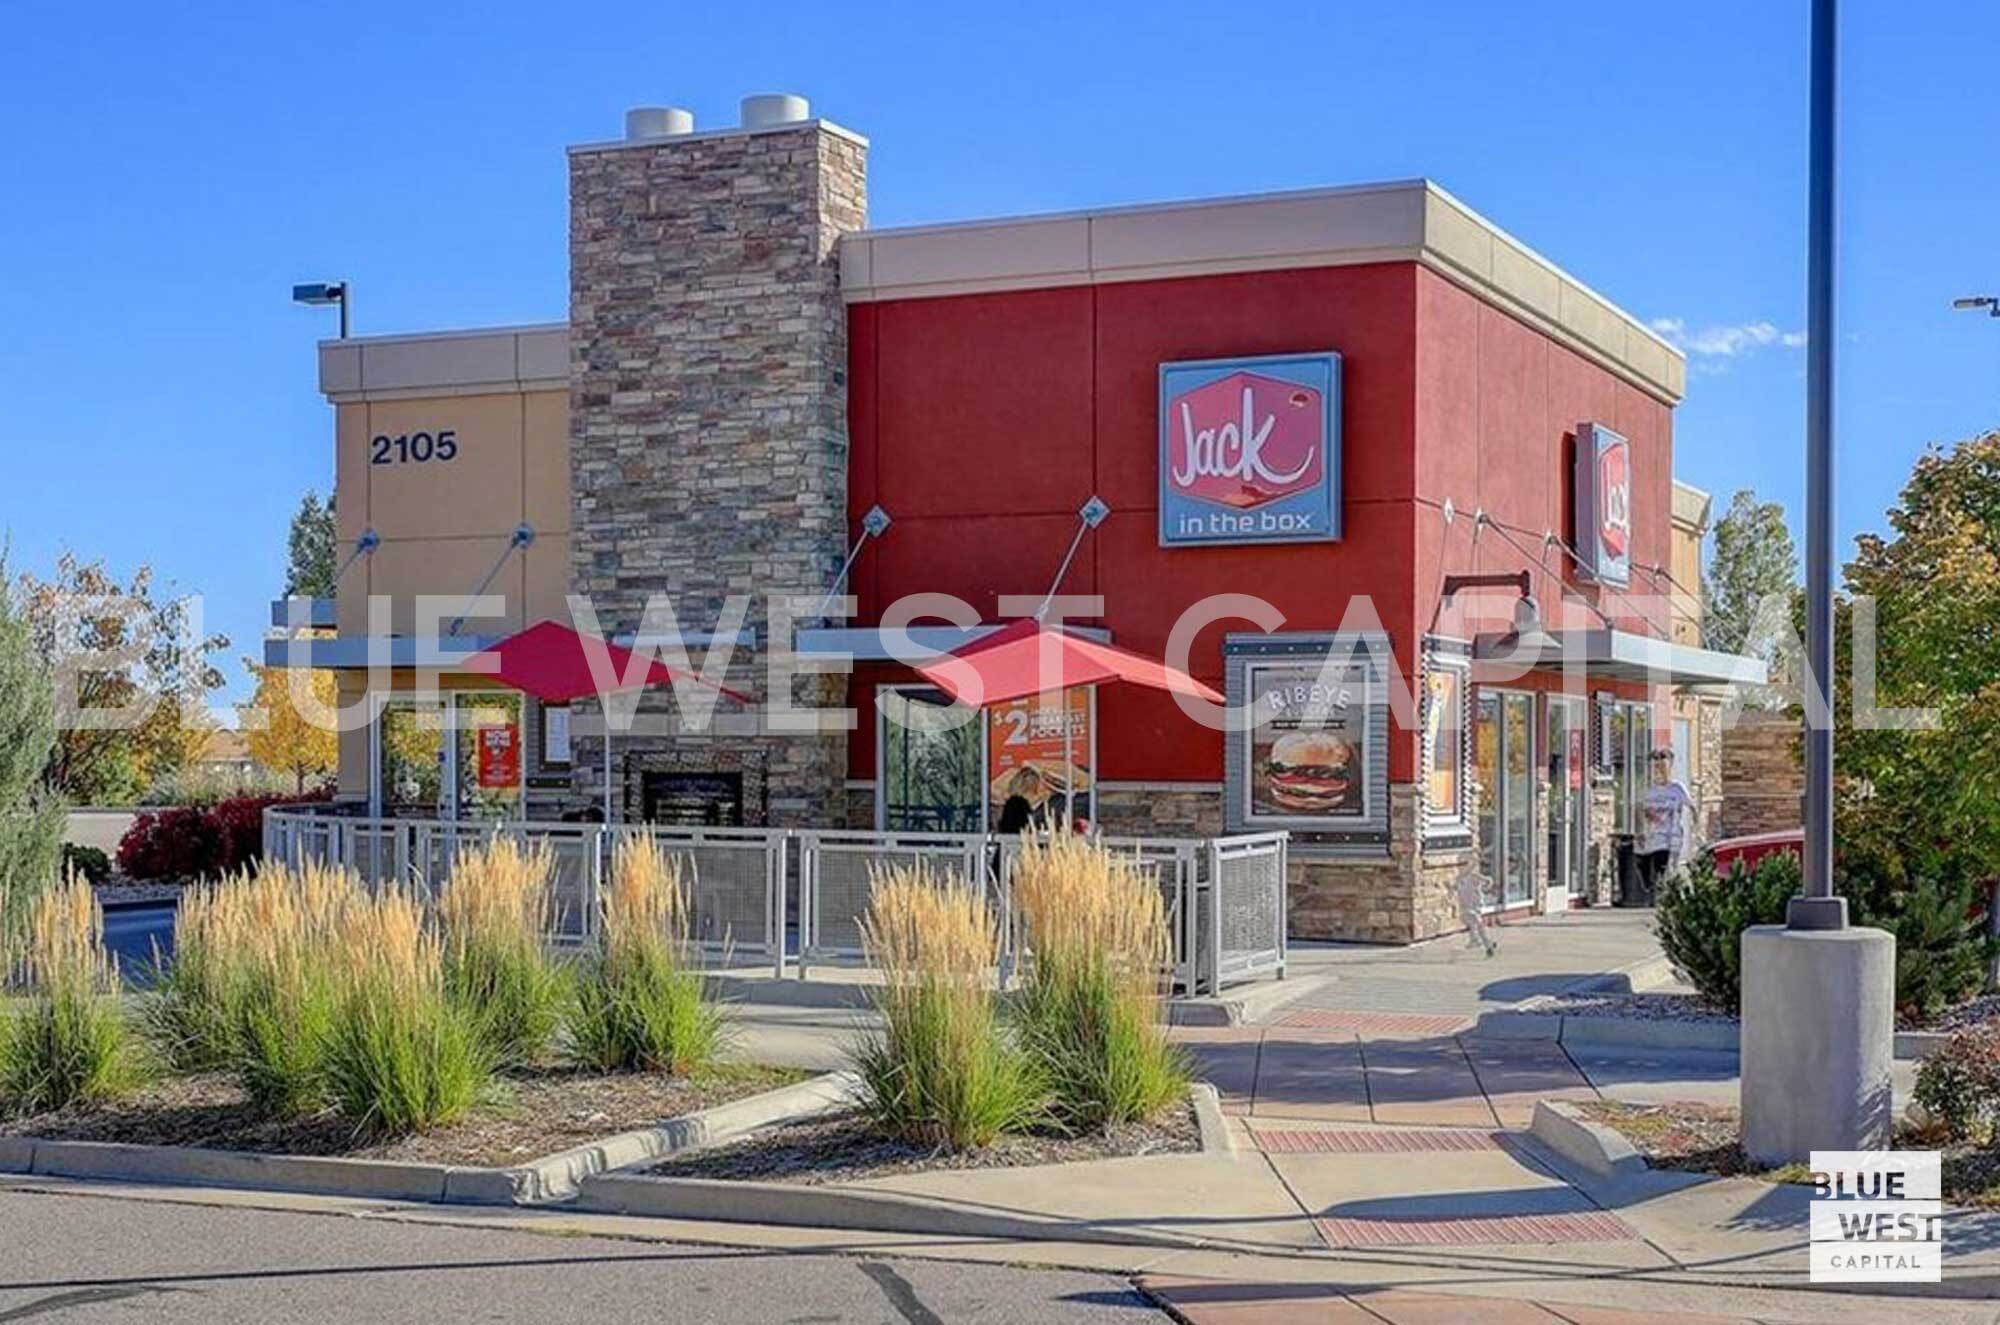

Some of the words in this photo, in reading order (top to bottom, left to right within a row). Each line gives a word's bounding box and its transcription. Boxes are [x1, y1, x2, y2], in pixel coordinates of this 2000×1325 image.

[371, 431, 457, 464] 2105
[1173, 387, 1314, 487] Jack
[1179, 513, 1203, 534] in
[1210, 512, 1254, 533] the
[1261, 511, 1311, 531] box
[1268, 683, 1351, 710] RIBEYE
[993, 709, 1028, 746] $2
[1030, 725, 1087, 738] POCKTS
